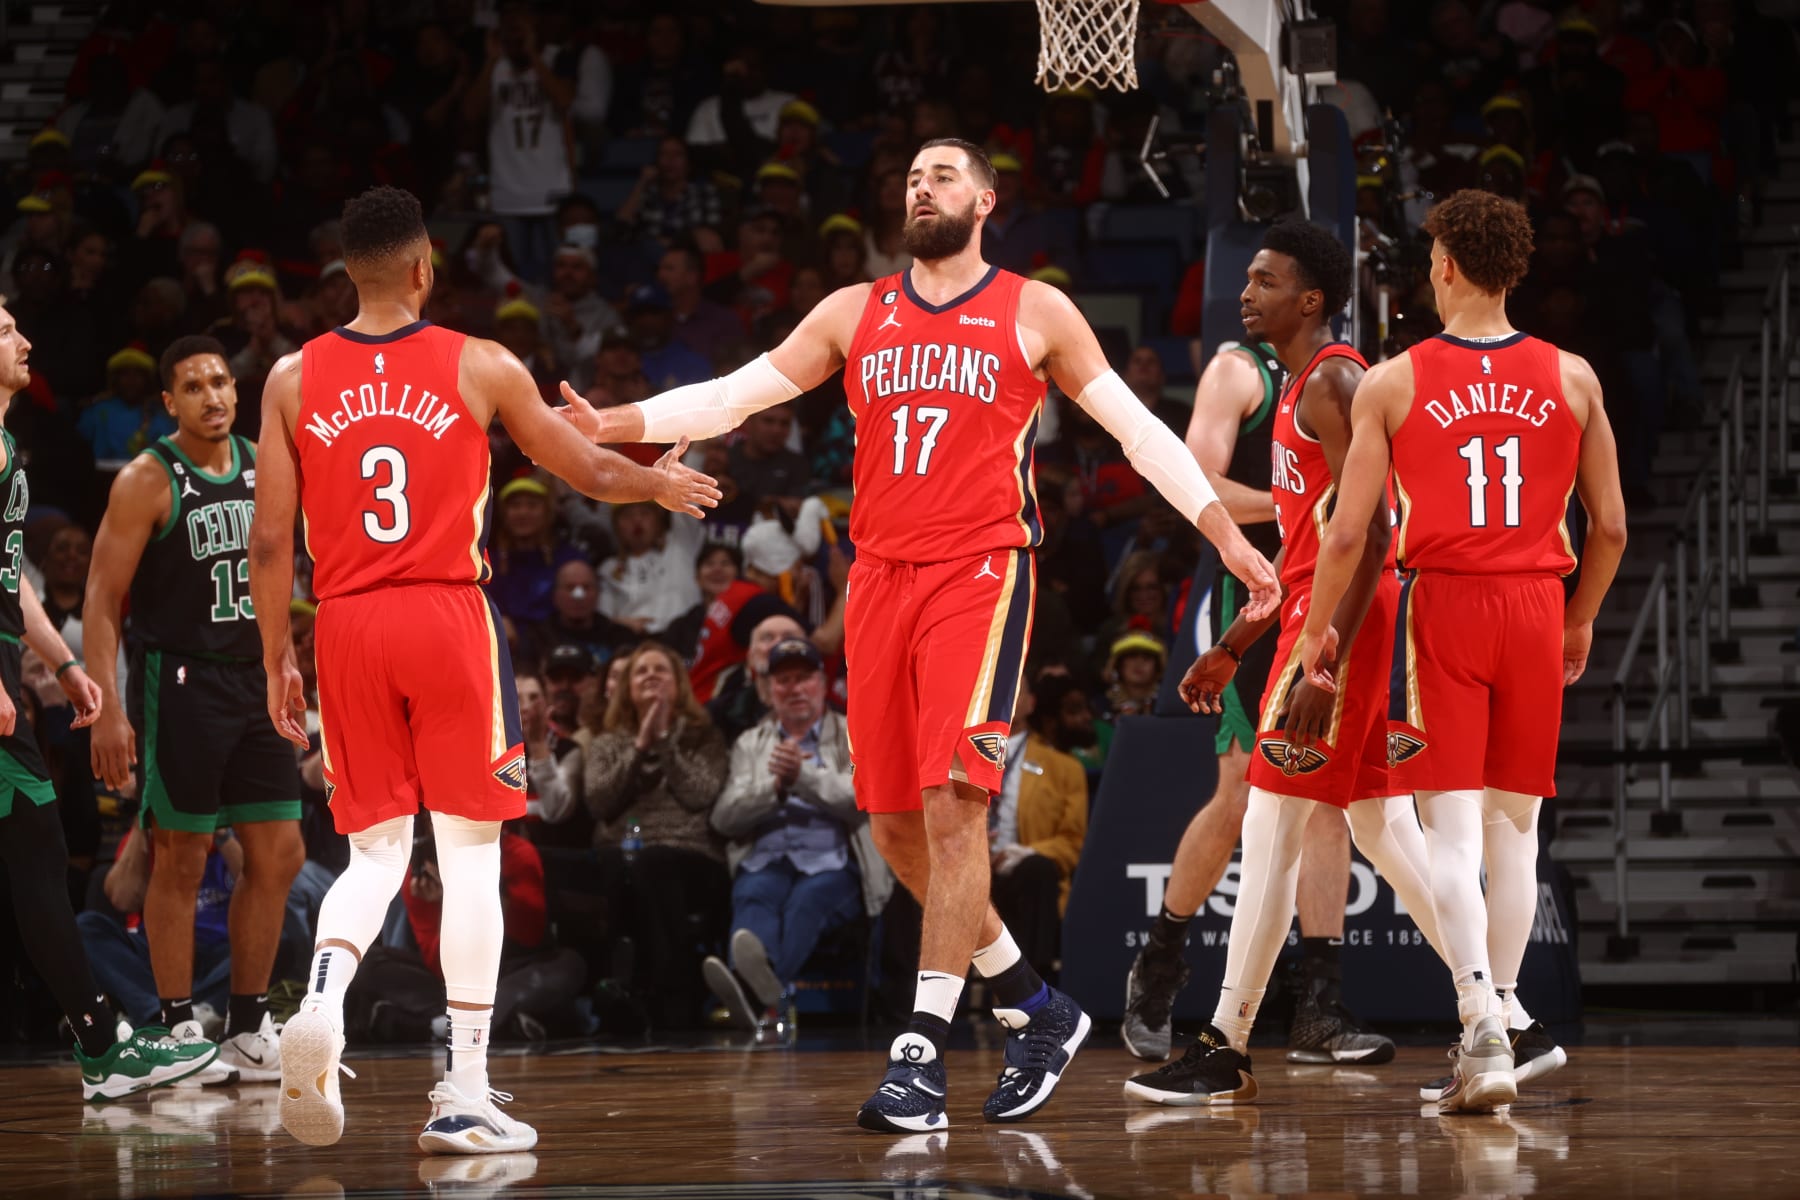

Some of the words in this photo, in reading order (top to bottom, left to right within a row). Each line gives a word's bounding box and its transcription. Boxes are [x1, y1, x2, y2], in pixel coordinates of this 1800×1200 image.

[513, 114, 542, 150] 17
[883, 291, 897, 304] 6
[959, 314, 995, 328] ibotta
[861, 343, 1000, 404] PELICANS
[305, 381, 461, 447] McCOLLUM
[1424, 382, 1557, 429] DANIELS
[891, 404, 950, 476] 17
[360, 444, 411, 544] 3
[1457, 435, 1525, 528] 11
[186, 500, 256, 561] CELTI
[1386, 929, 1431, 946] 185
